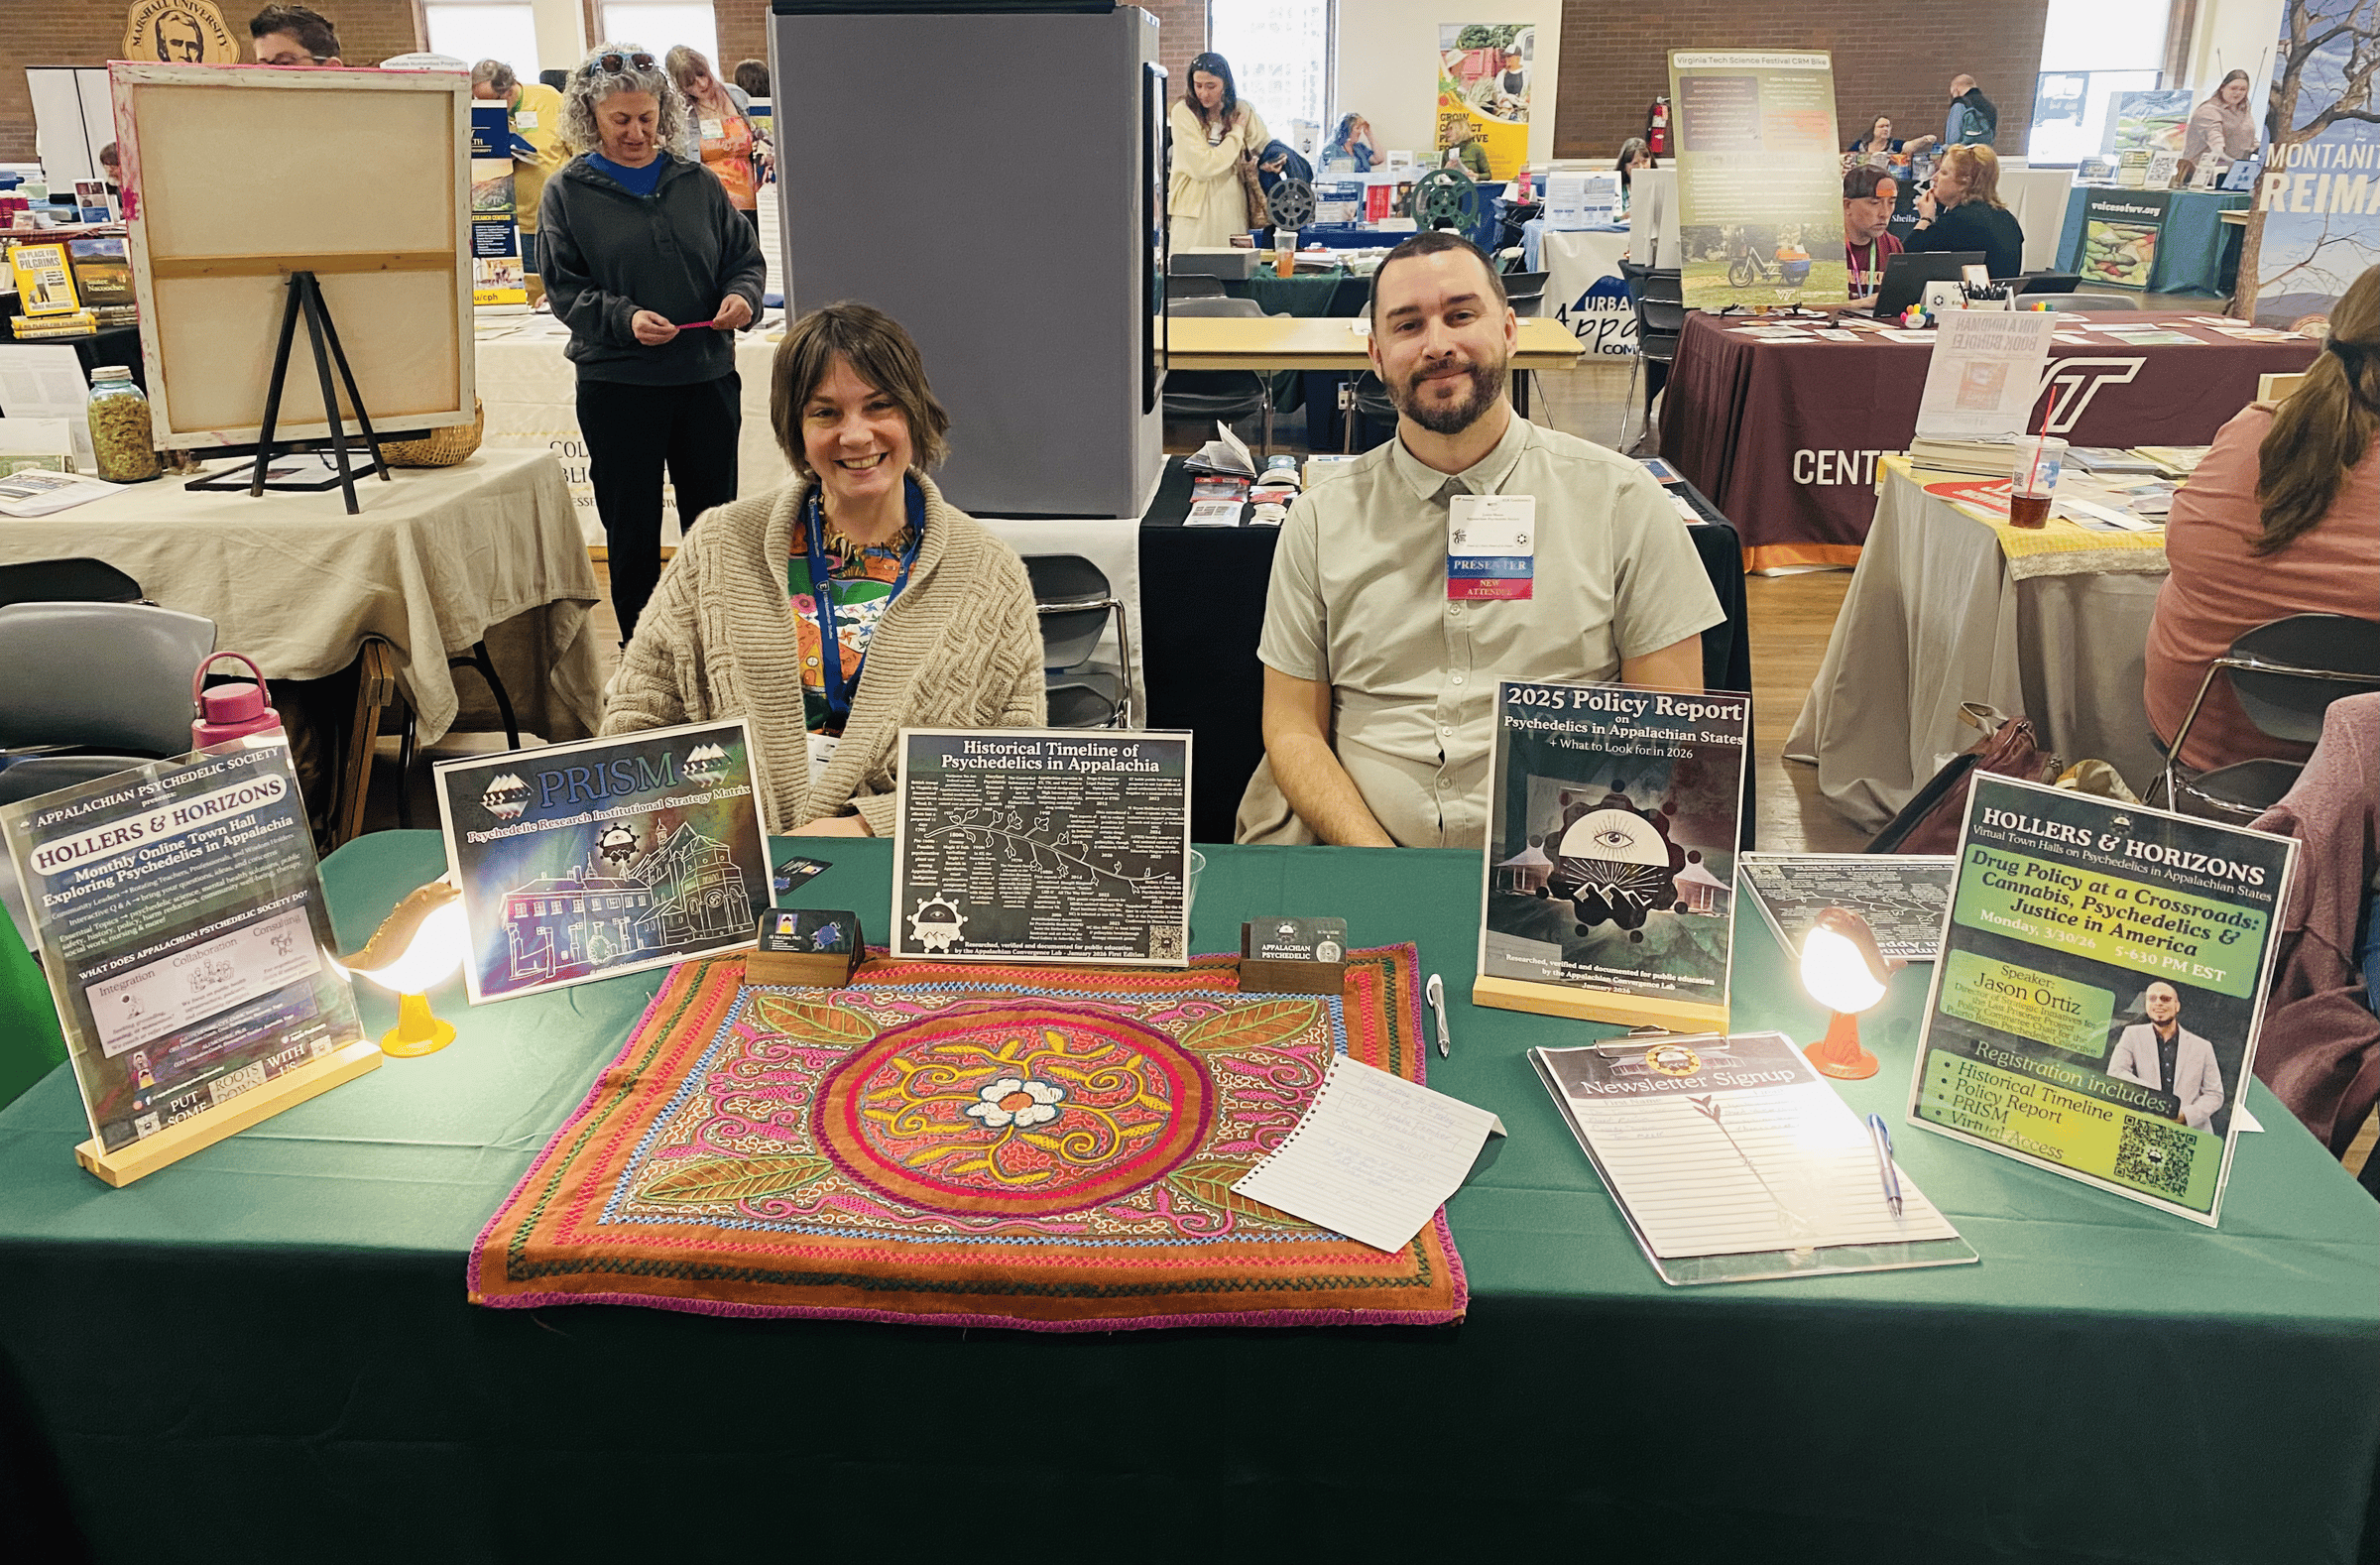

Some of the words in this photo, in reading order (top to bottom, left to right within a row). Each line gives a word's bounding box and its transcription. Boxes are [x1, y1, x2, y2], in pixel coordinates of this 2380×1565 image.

[133, 0, 169, 47] MARSHALL
[174, 0, 228, 47] UNIVERSITY
[2090, 200, 2162, 217] voicesofwv.org
[19, 257, 60, 270] PILGRIMS
[26, 250, 44, 259] PLACE
[1585, 296, 1634, 311] URBA
[1793, 449, 1911, 485] CENT
[1453, 560, 1527, 570] PRESENTER
[1506, 687, 1565, 709] 2025
[1572, 689, 1648, 717] Policy
[1654, 695, 1742, 722] Report
[1503, 715, 1588, 732] Psychedelics
[1592, 722, 1606, 734] in
[1607, 724, 1696, 741] Appalachian
[1700, 731, 1745, 746] States
[941, 754, 1042, 771] Psychedelics
[1046, 756, 1063, 770] in
[1067, 757, 1159, 774] Appalachia
[963, 740, 1040, 755] Historical
[1045, 742, 1118, 757] Timeline
[1122, 743, 1138, 757] of
[1559, 738, 1589, 750] What
[1591, 742, 1602, 751] to
[1605, 742, 1632, 753] Look
[1634, 744, 1651, 755] for
[1653, 745, 1663, 756] in
[1666, 747, 1693, 759] 2026
[37, 788, 134, 827] APPALACHIAN
[137, 762, 225, 794] PSYCHEDELIC
[226, 746, 278, 769] SOCIETY
[536, 752, 679, 808] PRISM
[36, 822, 143, 868] HOLLERS
[150, 814, 166, 832] &
[172, 780, 281, 825] HORIZONS
[466, 821, 537, 843] Psychedelic
[536, 811, 592, 830] Research
[592, 797, 664, 820] Institutional
[666, 790, 712, 808] Strategy
[713, 784, 752, 799] Matrix
[41, 876, 115, 906] Exploring
[115, 847, 202, 882] Psychedelics
[204, 841, 220, 852] in
[222, 816, 294, 846] Appalachia
[73, 855, 135, 882] Monthly
[138, 839, 185, 860] Online
[186, 826, 227, 844] Town
[228, 813, 256, 831] Hall
[1973, 824, 2005, 840] Virtual
[2007, 832, 2036, 847] Town
[2038, 839, 2063, 853] Halls
[2065, 848, 2079, 857] on
[2082, 849, 2148, 873] Psychedelics
[2150, 865, 2161, 876] in
[2163, 869, 2233, 893] Appalachian
[2236, 885, 2271, 902] States
[1981, 807, 2091, 846] HOLLERS
[2097, 833, 2120, 851] &
[2124, 838, 2265, 885] HORIZONS
[1970, 850, 2019, 876] Drug
[2024, 862, 2082, 891] Policy
[2088, 882, 2109, 895] at
[2114, 888, 2127, 900] a
[2134, 889, 2259, 930] Crossroads:
[1981, 871, 2074, 908] Cannabis,
[2081, 895, 2210, 939] Psychedelics
[2218, 928, 2240, 944] &
[78, 963, 107, 979] WHAT
[109, 953, 135, 969] DOES
[137, 930, 197, 959] APPALACHIAN
[198, 908, 256, 935] PSYCHEDELIC
[256, 896, 290, 913] SOCIETY
[291, 890, 307, 901] DO?
[253, 914, 301, 937] Consulting
[2009, 898, 2078, 925] Justice
[2083, 915, 2102, 932] in
[2108, 922, 2197, 956] America
[173, 938, 237, 969] Collaboration
[1979, 908, 2038, 935] Monday,
[2043, 926, 2095, 948] 3/30/26
[2114, 945, 2157, 964] 5-630
[2161, 955, 2188, 972] PM
[2192, 963, 2226, 981] EST
[99, 970, 155, 996] Integration
[1505, 953, 1548, 966] Researched,
[1549, 960, 1577, 970] verified
[1593, 964, 1638, 976] documented
[1652, 972, 1676, 981] public
[1677, 975, 1715, 985] education
[1541, 968, 1552, 978] by
[1566, 971, 1611, 984] Appalachian
[1612, 976, 1660, 990] Convergence
[1661, 982, 1676, 991] Lab
[2000, 964, 2055, 989] Speaker:
[1581, 982, 1611, 994] January
[1973, 972, 2026, 1000] Jason
[2034, 989, 2081, 1015] Ortiz
[1580, 1073, 1709, 1096] Newsletter
[1713, 1069, 1795, 1086] Signup
[1958, 1061, 2036, 1097] Historical
[2041, 1086, 2112, 1121] Timeline
[1974, 1039, 2082, 1087] Registration
[2087, 1074, 2171, 1114] includes:
[1604, 1098, 1628, 1107] First
[1630, 1097, 1662, 1106] Name
[1953, 1094, 2008, 1124] PRISM
[1955, 1077, 2001, 1106] Policy
[2005, 1094, 2062, 1124] Report
[1952, 1110, 2005, 1139] Virtual
[2007, 1131, 2064, 1159] Access
